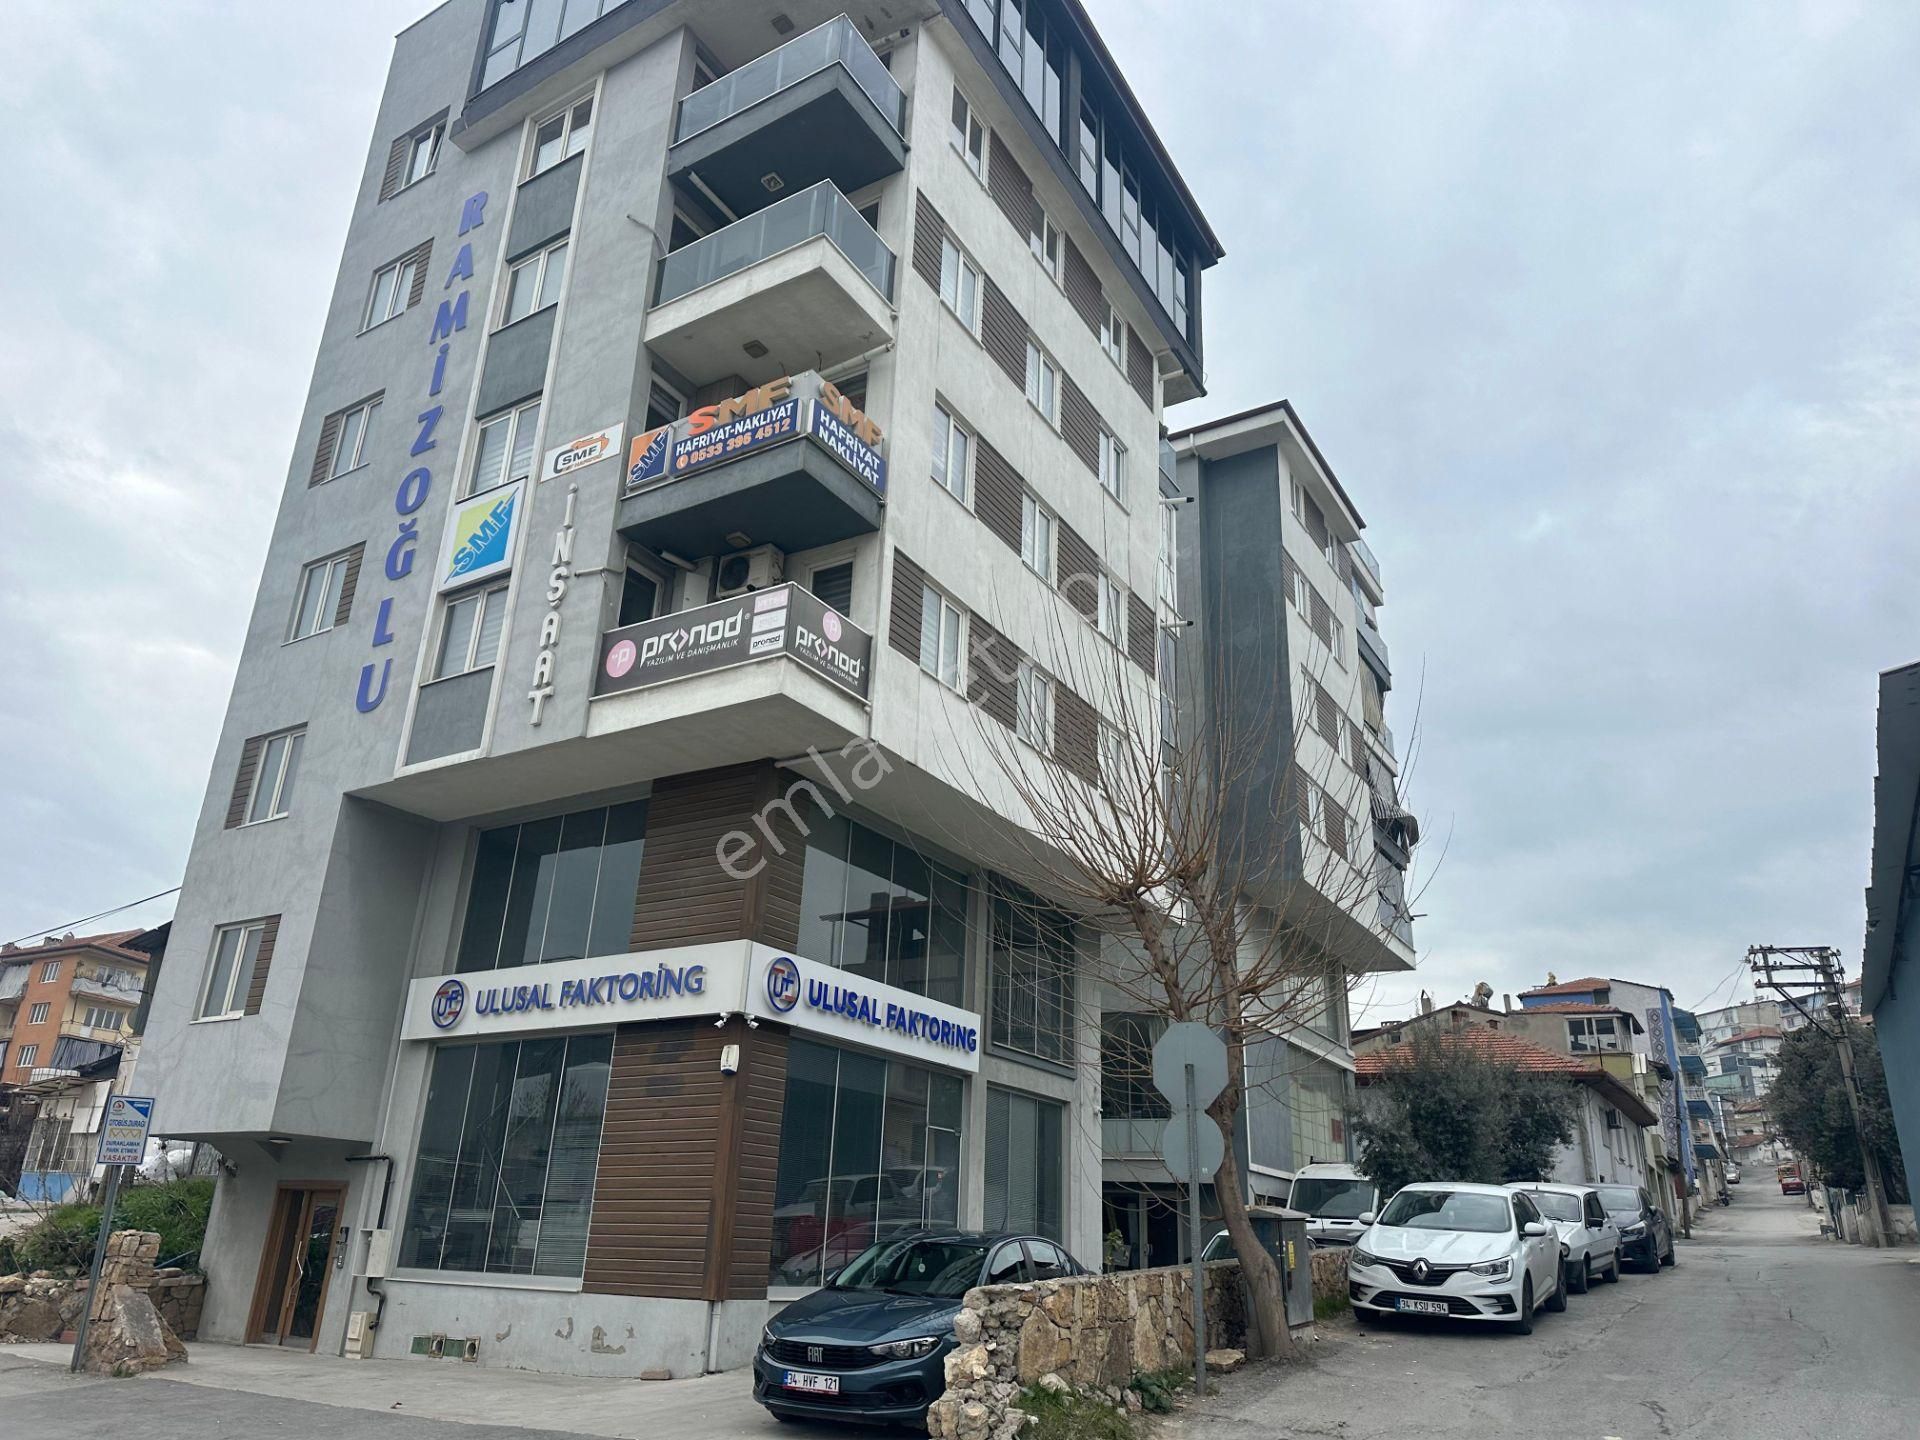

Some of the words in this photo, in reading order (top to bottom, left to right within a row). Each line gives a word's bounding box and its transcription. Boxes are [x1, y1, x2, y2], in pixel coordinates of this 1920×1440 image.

[676, 402, 794, 456] HAFRİYAT-NAKLİYAT
[688, 376, 792, 436] SMF
[819, 381, 884, 446] SMF
[356, 190, 488, 714] RAMİZOĞLU
[561, 445, 598, 466] SMF
[630, 431, 667, 481] SMF
[818, 425, 879, 485] NAKLİYAT
[820, 409, 880, 470] HAFRİYAT
[453, 499, 510, 573] SMF
[528, 482, 578, 727] İNŞAAT
[676, 651, 685, 660] VE
[687, 638, 738, 657] DANIŞMANLIK
[475, 983, 554, 1015] ULUSAL
[559, 963, 705, 1008] FAKTORİNG
[808, 978, 882, 1026] ULUSAL
[886, 1003, 977, 1052] FAKTORİNG
[1401, 1299, 1410, 1309] 34
[1413, 1301, 1429, 1311] KSU
[1431, 1303, 1446, 1313] 594
[788, 1373, 798, 1386] 34
[803, 1375, 819, 1388] HVF
[824, 1377, 838, 1391] 121
[807, 1346, 824, 1363] FIAT
